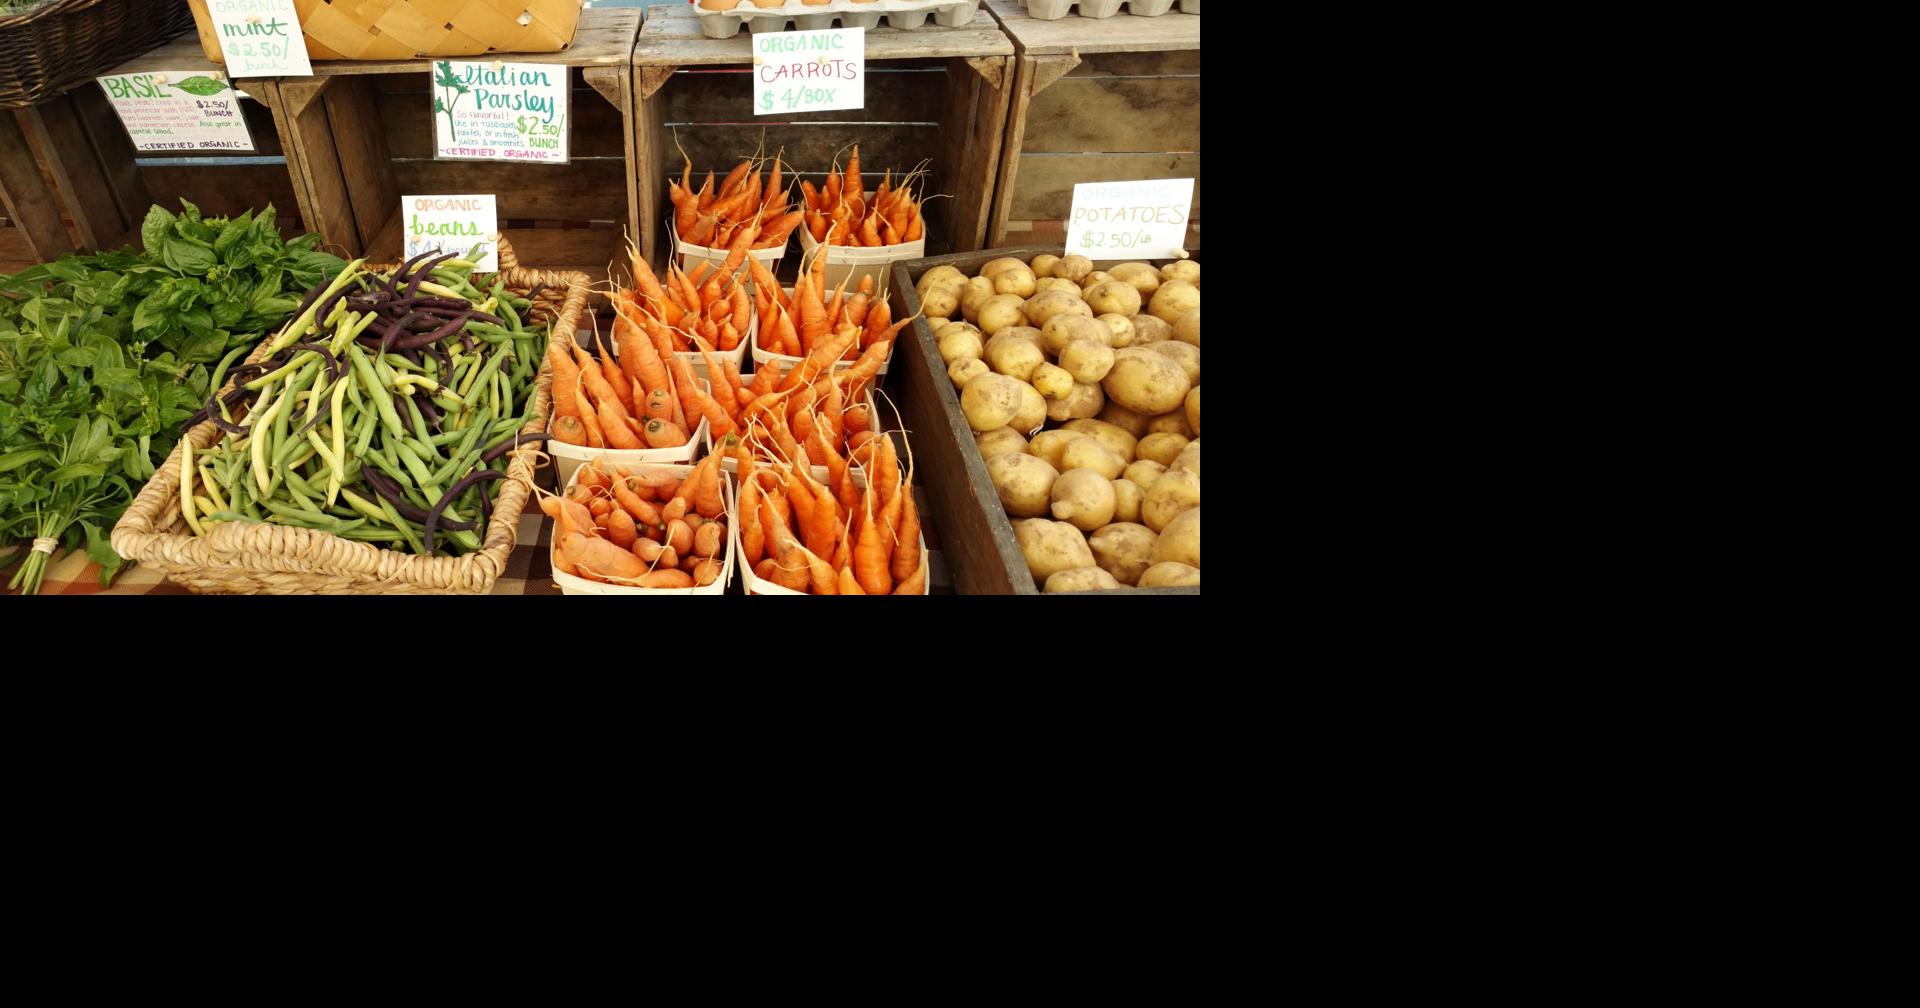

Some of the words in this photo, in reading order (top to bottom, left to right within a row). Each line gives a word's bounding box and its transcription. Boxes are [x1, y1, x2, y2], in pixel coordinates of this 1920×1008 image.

[215, 0, 289, 13] ORGANIC
[222, 17, 288, 37] mint
[227, 36, 289, 60] $2.50/
[759, 33, 844, 53] ORGANIC
[241, 59, 289, 72] bunch
[457, 64, 551, 87] Italian
[760, 59, 857, 83] CARROTS
[103, 74, 173, 98] BASIL
[195, 100, 229, 110] $2.50/
[204, 109, 234, 118] BUNCH
[456, 111, 467, 119] So
[474, 88, 555, 124] Parsley
[470, 119, 479, 127] in
[517, 113, 565, 138] $2.50/
[529, 137, 559, 149] BUNCH
[1081, 185, 1171, 200] ORGANIC
[414, 198, 482, 212] ORGANIC
[1073, 204, 1185, 225] POTATOES
[408, 213, 484, 236] beans
